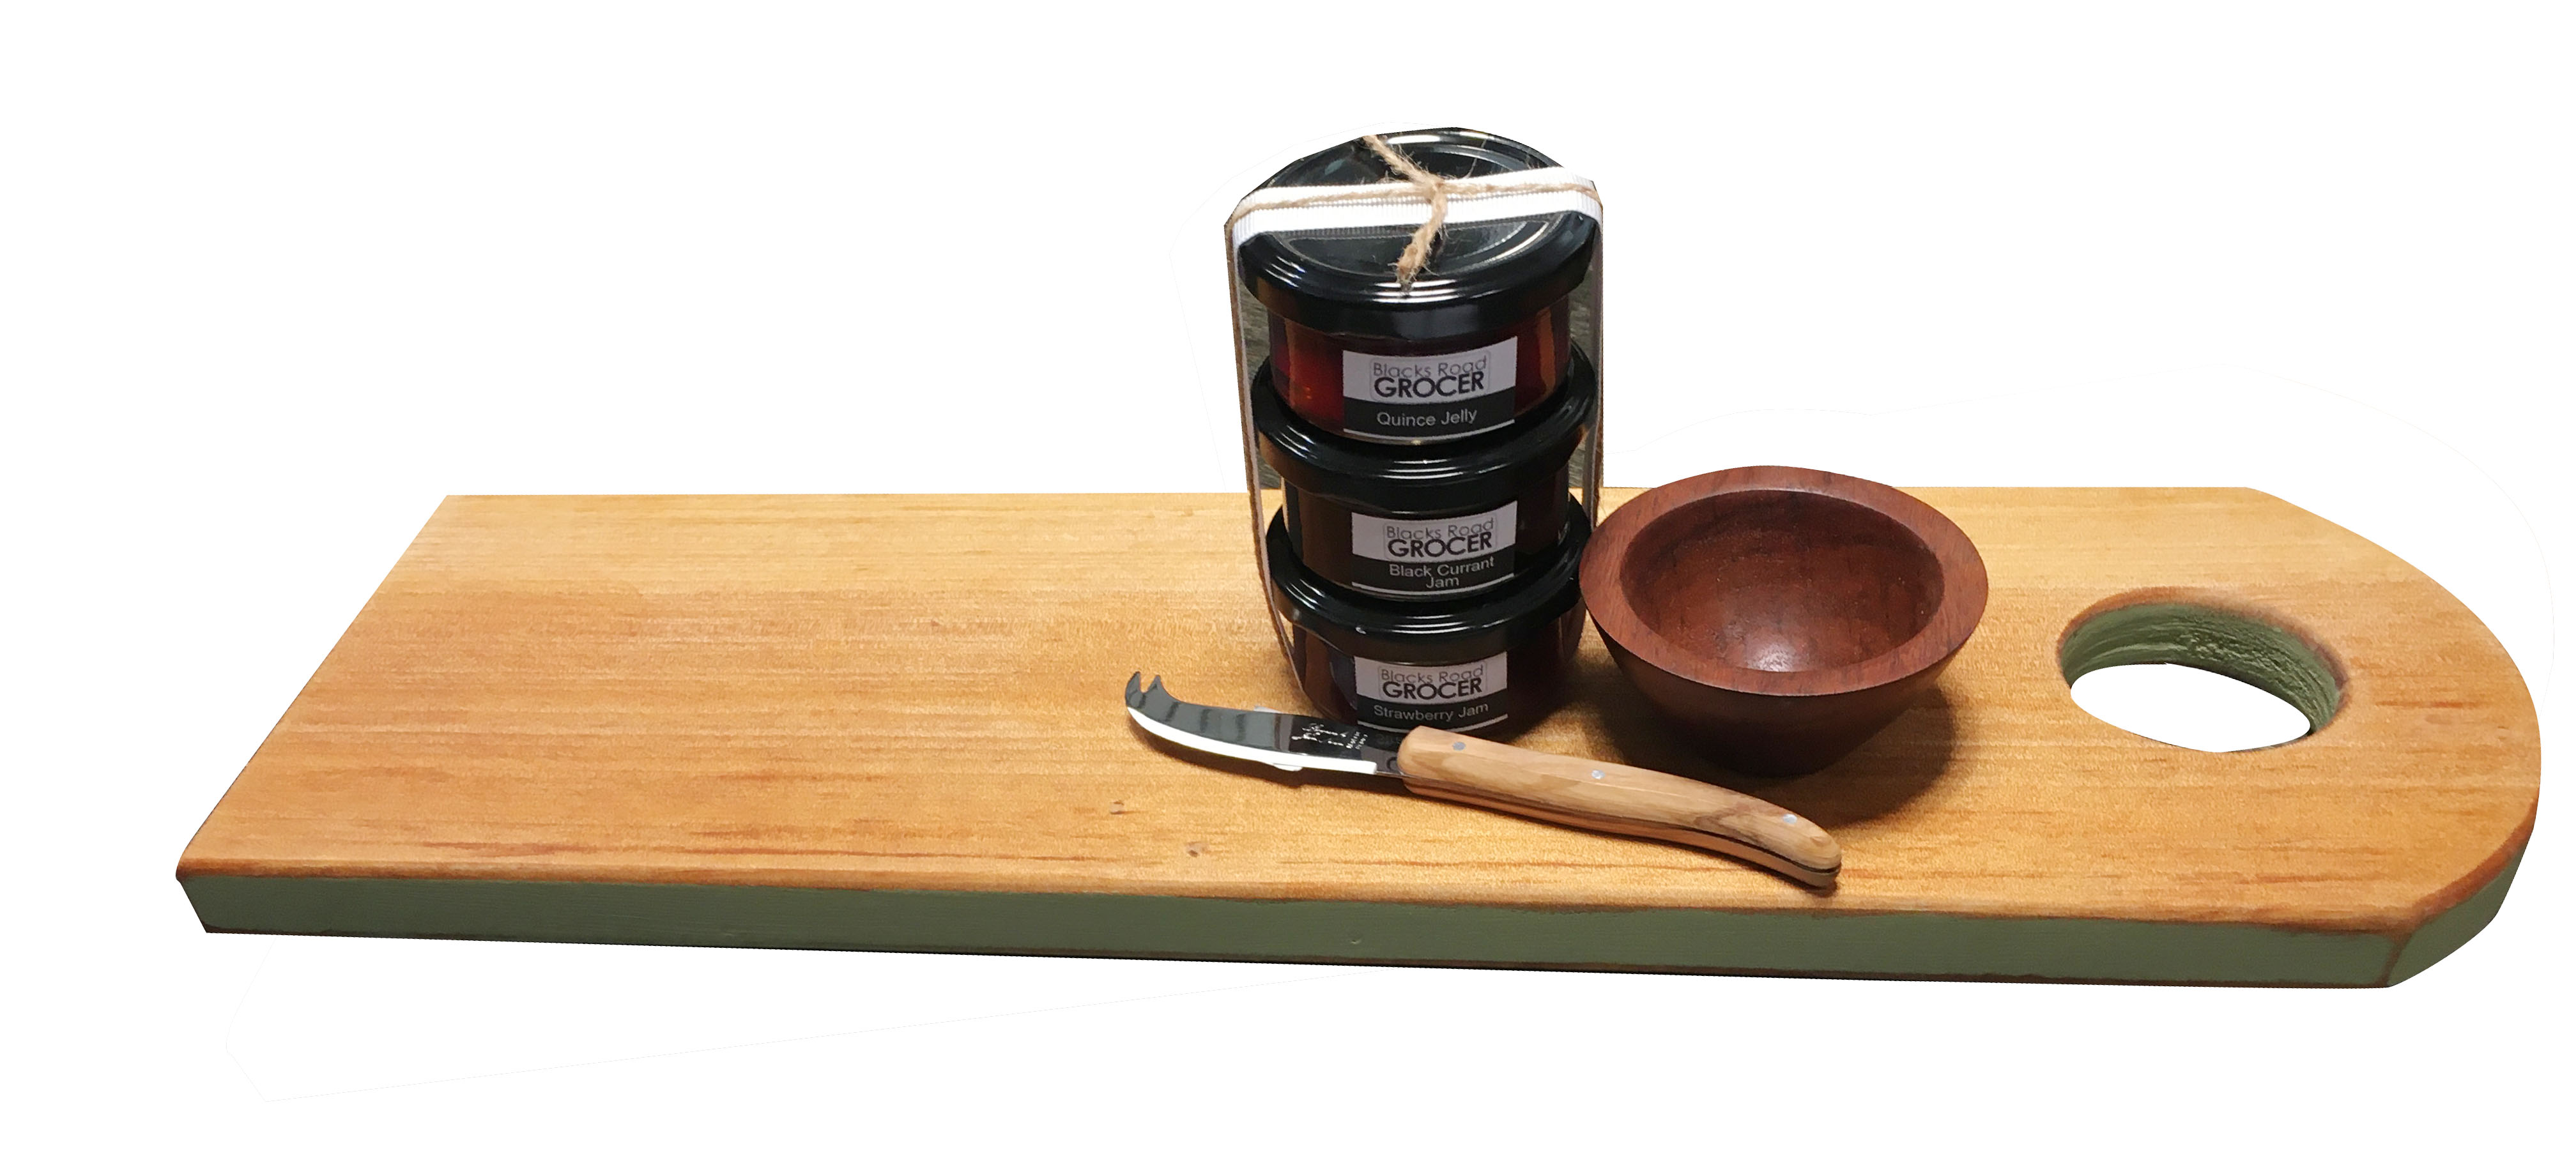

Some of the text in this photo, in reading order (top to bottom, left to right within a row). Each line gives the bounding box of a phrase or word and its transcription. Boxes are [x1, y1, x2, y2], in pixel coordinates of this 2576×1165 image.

[1374, 355, 1487, 378] Blacks Road
[1374, 371, 1484, 398] GROCER
[1377, 409, 1477, 427] Quince Jelly
[1386, 517, 1494, 540] Blacks Road
[1388, 531, 1492, 558] GROCER
[1390, 556, 1494, 577] Black Currant
[1426, 576, 1459, 588] Jam
[1381, 665, 1483, 684] Blacks Road
[1383, 677, 1482, 700] GROCER
[1374, 703, 1489, 722] Strawberry Jam
